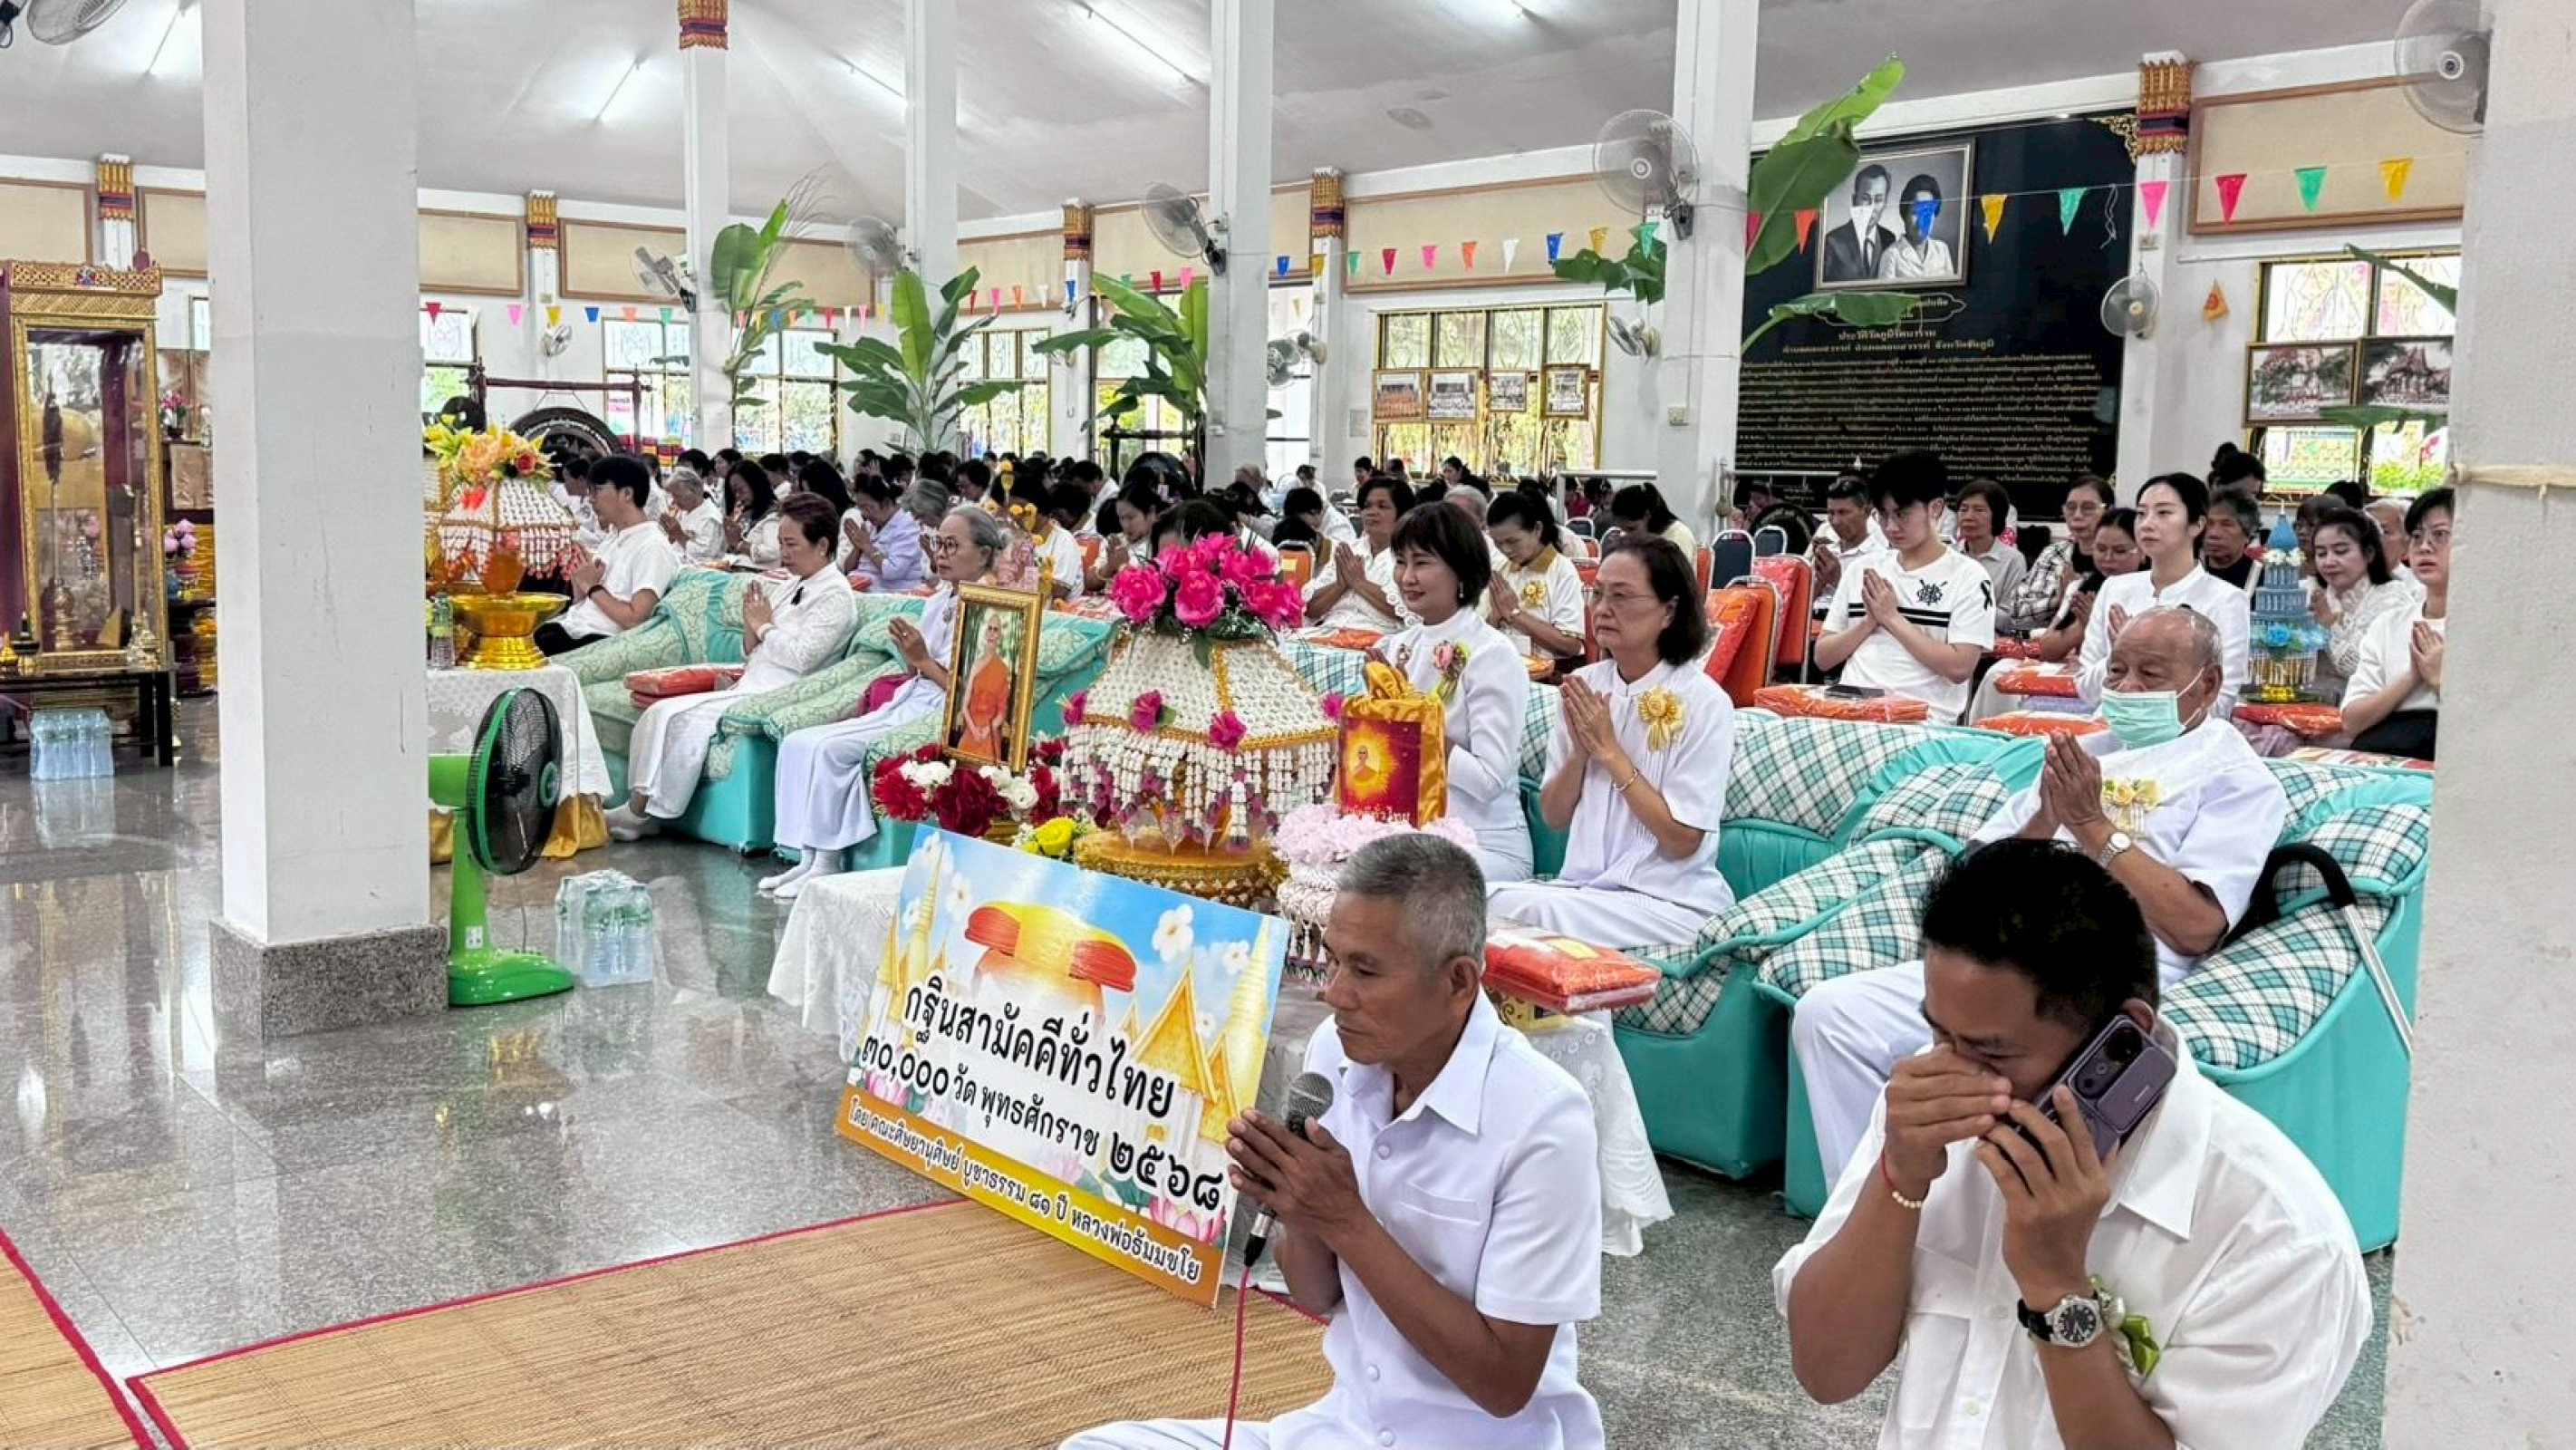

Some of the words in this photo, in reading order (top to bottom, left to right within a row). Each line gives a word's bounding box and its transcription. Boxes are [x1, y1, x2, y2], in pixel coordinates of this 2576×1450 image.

[904, 975, 1174, 1117] กฐินสามัคคีทั่วไทย
[861, 1035, 950, 1096] ๓๐,๐๐๐
[953, 1062, 977, 1107] วัด
[980, 1087, 1100, 1156] พุทธศักราช
[1111, 1131, 1224, 1211] ๒๕๖๘
[963, 1159, 1027, 1203] บูชาธรรม
[1029, 1193, 1050, 1214] ๘๑
[1056, 1194, 1068, 1221] ปี
[1071, 1209, 1200, 1281] หลวงพ่อธัมมชโย
